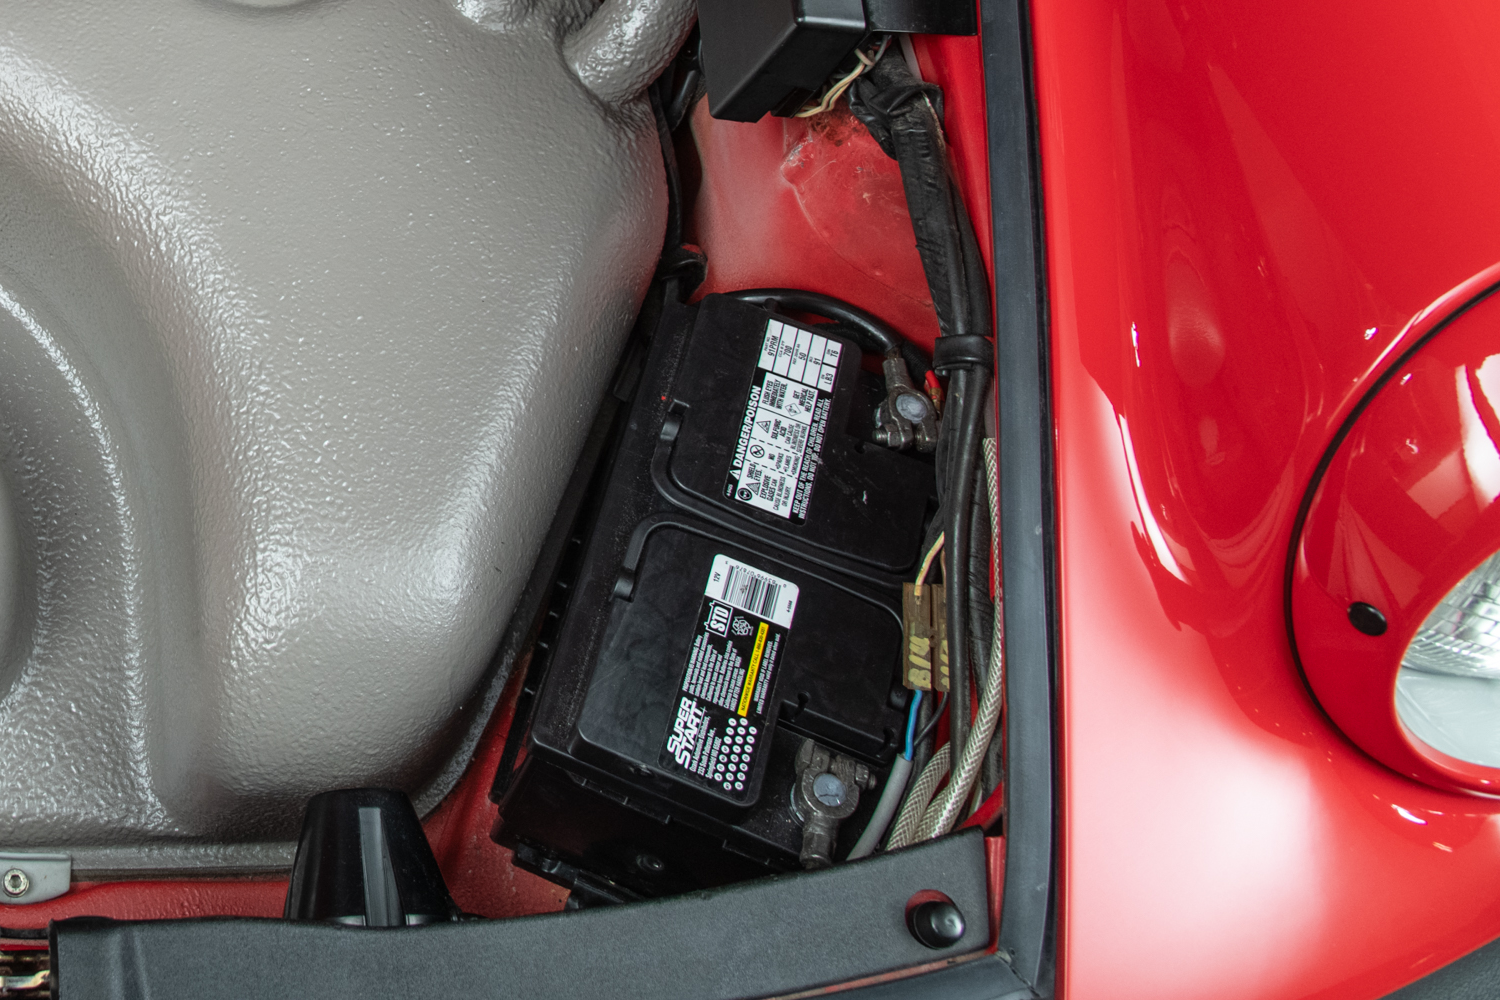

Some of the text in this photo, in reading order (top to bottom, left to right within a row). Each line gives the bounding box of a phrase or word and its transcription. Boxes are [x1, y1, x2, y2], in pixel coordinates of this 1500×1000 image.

[766, 335, 778, 356] 91PRM
[782, 344, 792, 356] 700
[797, 351, 806, 360] 50
[813, 357, 821, 365] 91
[824, 372, 833, 384] LB3
[761, 380, 773, 405] FLUSH EYES
[768, 378, 781, 407] IMMEDIATELY
[792, 390, 800, 399] GET
[798, 387, 808, 406] MEDICAL
[804, 401, 812, 412] HELP
[732, 384, 761, 468] DANGER/POISON
[770, 418, 781, 440] SULFURIC
[778, 425, 786, 437] ACID
[768, 452, 775, 460] NO
[746, 462, 756, 479] SHIELD
[759, 474, 770, 498] EXPLOSIVE
[767, 486, 775, 501] GASES
[712, 571, 721, 582] 12V
[708, 604, 730, 632] STD
[665, 694, 693, 755] SUPER
[673, 699, 704, 769] START
